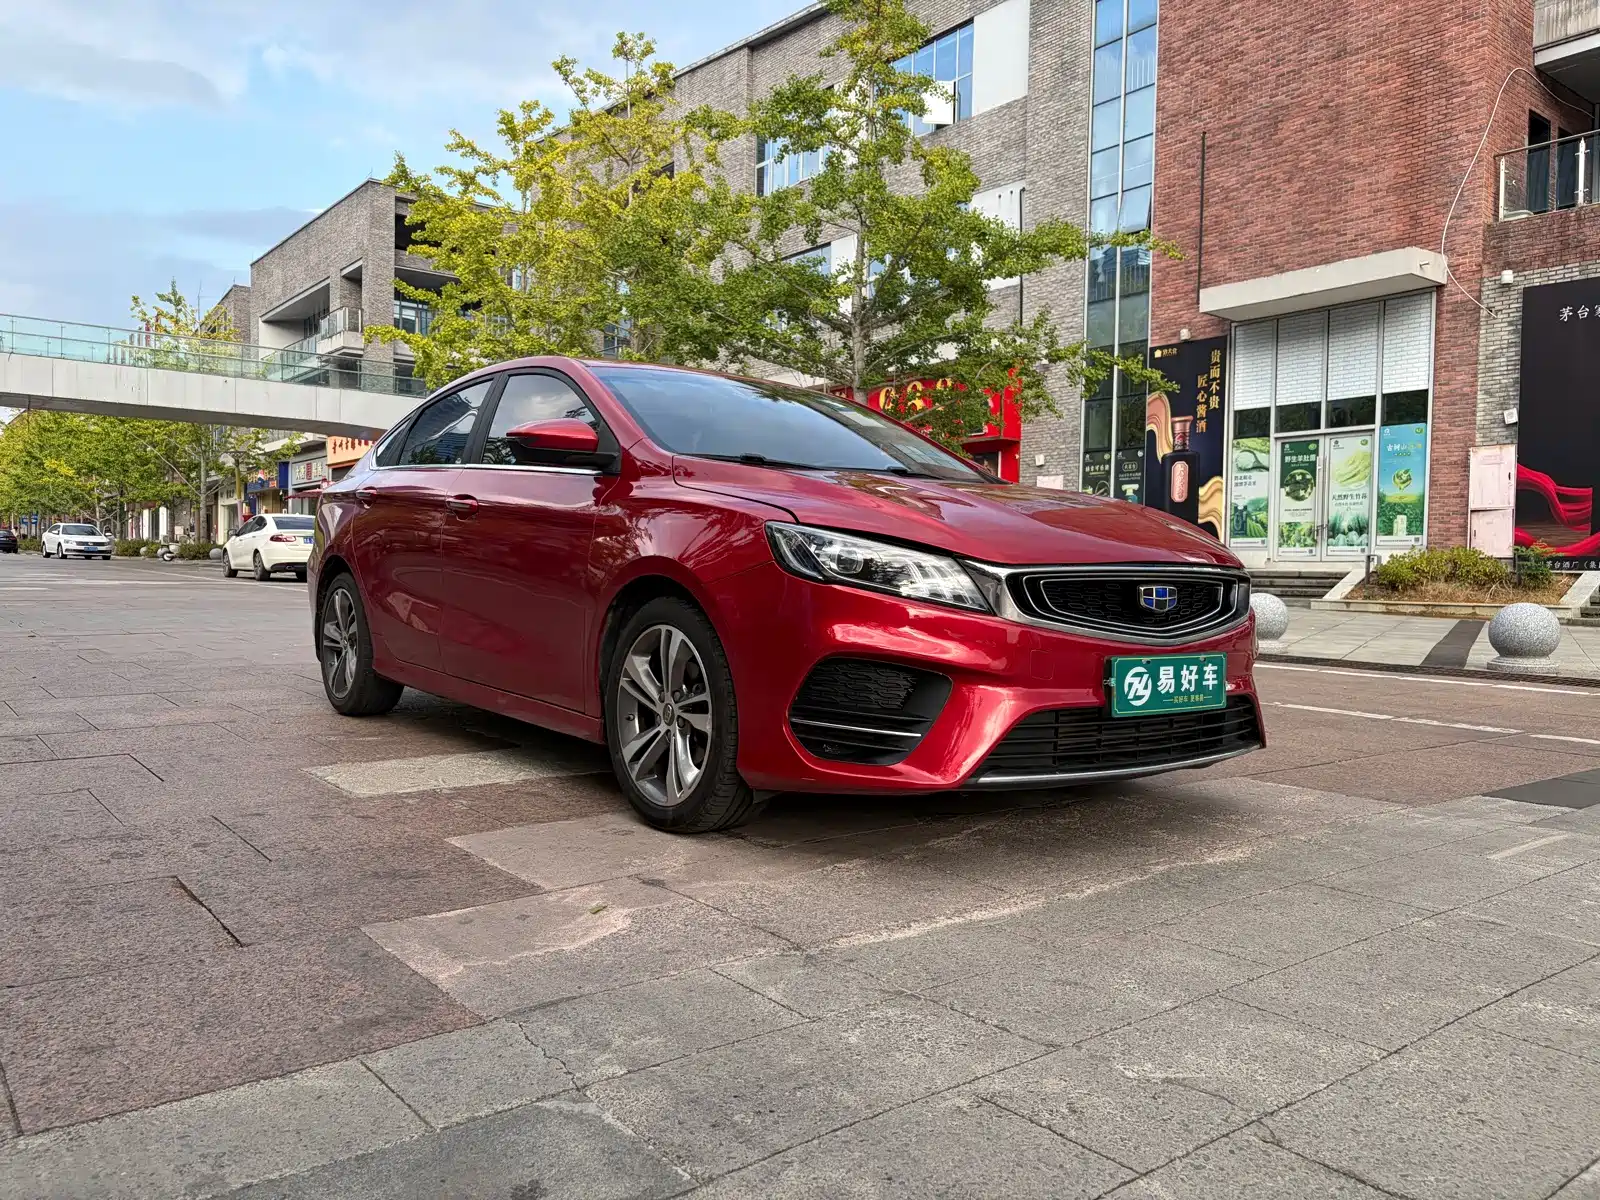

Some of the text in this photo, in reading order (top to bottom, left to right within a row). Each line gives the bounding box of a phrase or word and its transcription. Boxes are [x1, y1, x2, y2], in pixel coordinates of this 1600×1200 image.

[1209, 349, 1221, 410] 贵而不贵
[1196, 373, 1208, 433] 匠心酱酒
[1540, 560, 1600, 570] 茅台酒厂（集
[1157, 663, 1218, 694] 易好车
